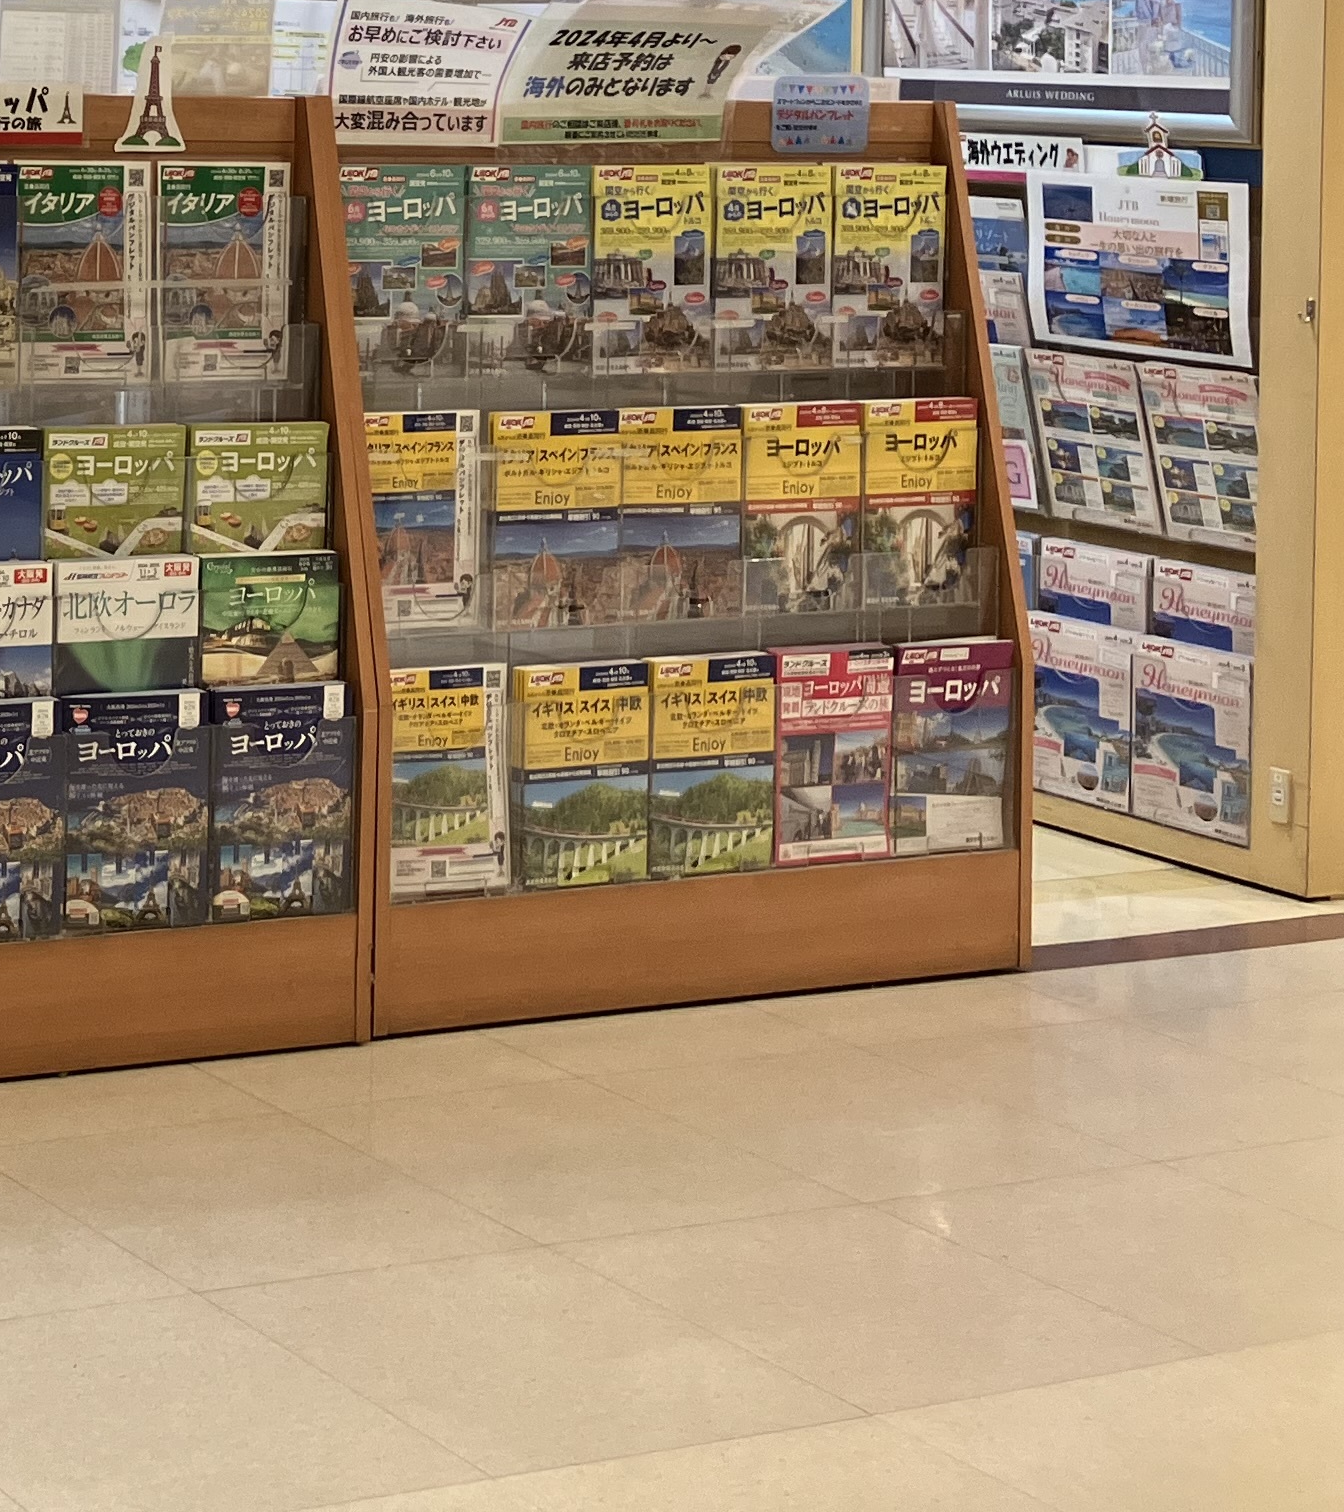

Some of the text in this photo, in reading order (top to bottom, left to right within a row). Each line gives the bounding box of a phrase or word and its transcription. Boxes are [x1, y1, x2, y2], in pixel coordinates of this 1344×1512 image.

[350, 11, 456, 25] 国内旅行も! 海外旅行も!
[496, 17, 518, 27] JTB
[348, 25, 502, 50] お早めにご検討下さい
[370, 53, 442, 65] 円安の影響による
[568, 52, 674, 71] 来店予約は
[523, 76, 695, 99] 海外のみとなります
[1006, 90, 1094, 101] ARLUIS WEDDING
[335, 110, 488, 132] 大変混み合っています
[777, 109, 855, 121] デジタルパンフレット
[966, 139, 1059, 167] 海外ウエディング
[24, 191, 95, 215] イタリア
[166, 192, 235, 215] イタリア
[367, 192, 456, 223] ヨーロッパ
[499, 193, 583, 222] ヨーロッパ
[623, 192, 705, 220] ヨーロッパ
[746, 193, 826, 220] ヨーロッパ
[862, 192, 940, 220] ヨーロッパ
[1118, 200, 1139, 211] JTB
[1113, 230, 1157, 242] 大切な人と
[395, 441, 455, 453] スペイン フランス
[661, 441, 738, 457] スペイン フランス
[766, 435, 841, 457] ヨーロッパ
[885, 430, 957, 452] ヨーロッパ
[76, 451, 174, 476] ヨーロッパ
[221, 448, 317, 473] ヨーロッパ
[392, 477, 418, 488] Enjoy
[656, 484, 693, 500] Enjoy
[782, 480, 815, 496] Enjoy
[901, 474, 933, 490] Enjoy
[534, 490, 570, 505] Enjoy
[229, 579, 317, 607] ヨーロッパ
[1045, 564, 1137, 605] Honeymoon
[64, 591, 196, 620] 北欧オーロラ
[783, 659, 828, 669] ランドクルーズ
[1031, 636, 1126, 682] Honeymoon
[909, 676, 1001, 703] ヨーロッパ
[1141, 662, 1245, 708] Honeymoon
[461, 694, 479, 707] 中欧
[532, 696, 642, 717] イギリス スイス 中欧
[661, 687, 768, 708] イギリス スイス 中欧
[115, 728, 156, 738] とっておきの
[264, 719, 301, 730] とっておきの
[77, 735, 172, 762] ヨーロッパ
[230, 725, 317, 755] ヨーロッパ
[417, 734, 449, 747] Enjoy
[692, 737, 726, 753] Enjoy
[565, 746, 599, 762] Enjoy
